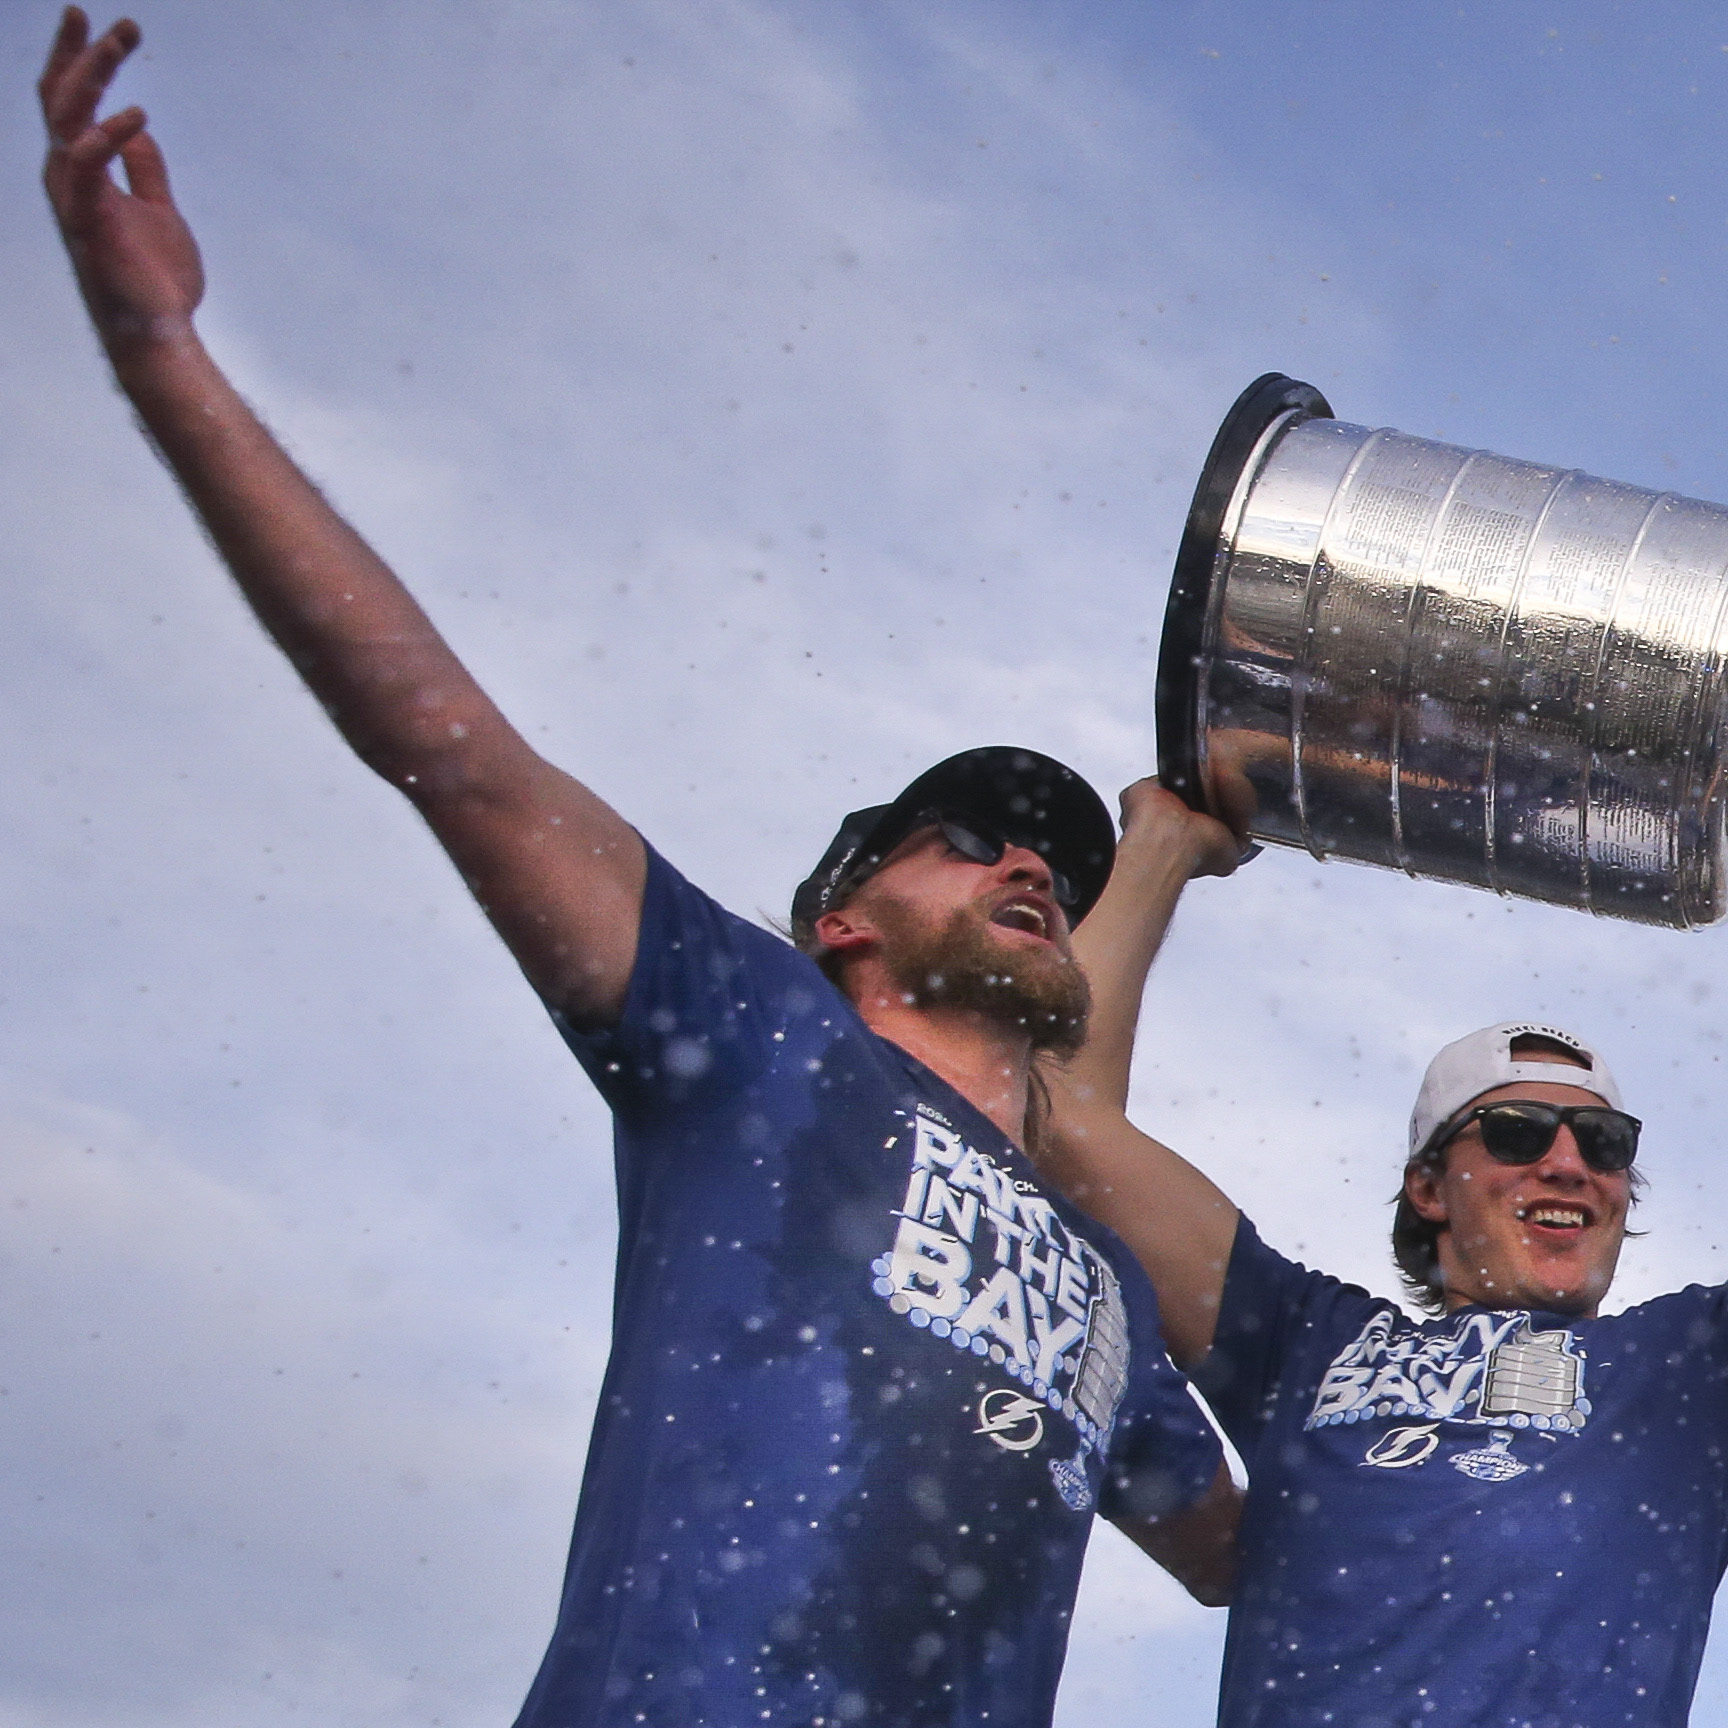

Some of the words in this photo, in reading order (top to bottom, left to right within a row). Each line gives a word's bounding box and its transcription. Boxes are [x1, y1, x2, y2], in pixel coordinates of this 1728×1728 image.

[900, 1168, 979, 1244] IN
[986, 1205, 1090, 1323] THE
[890, 1216, 1088, 1386] BAY
